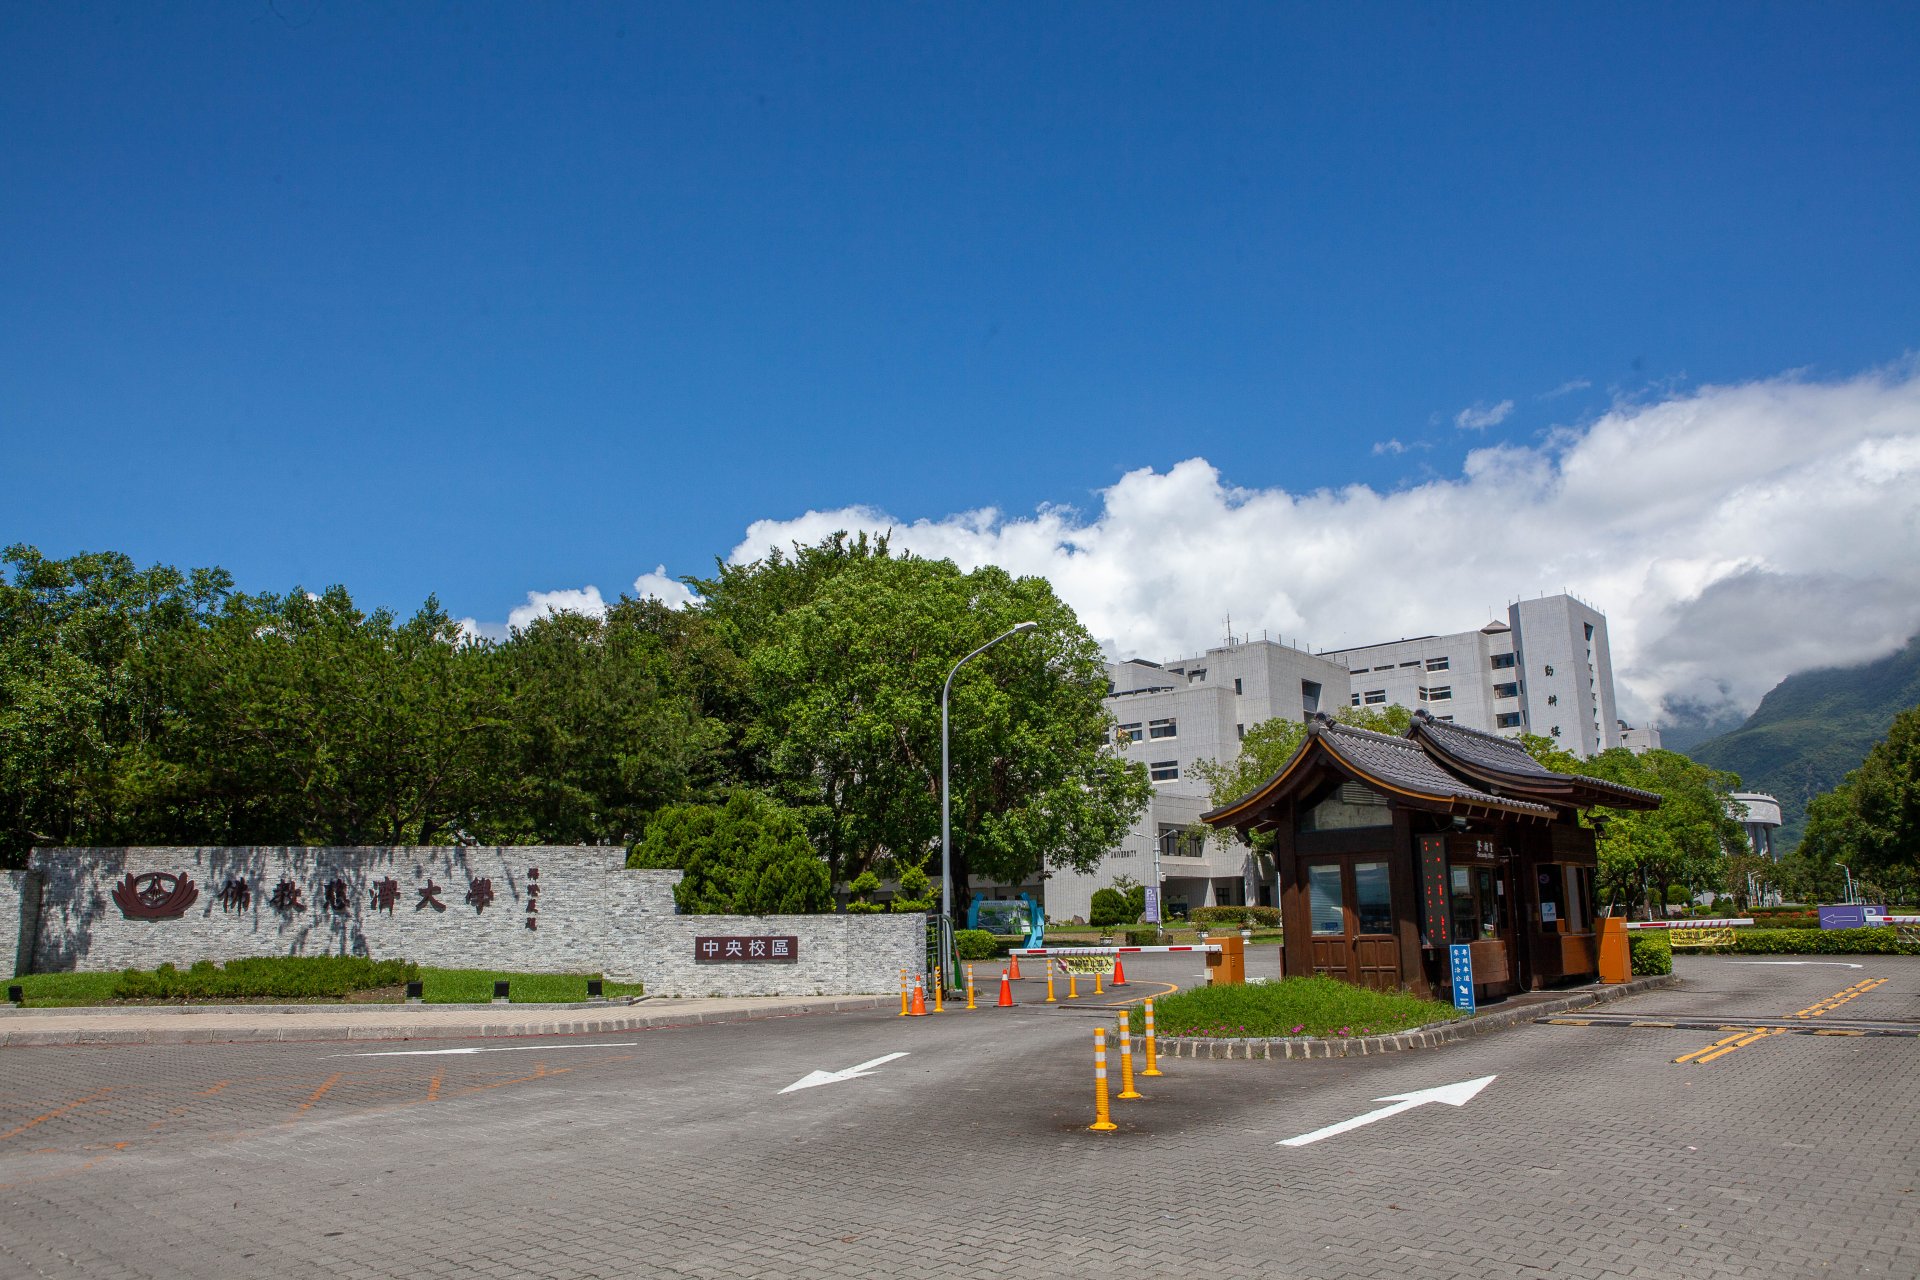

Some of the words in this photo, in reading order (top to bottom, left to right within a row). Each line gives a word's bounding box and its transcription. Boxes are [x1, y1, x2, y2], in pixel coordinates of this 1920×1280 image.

[219, 876, 494, 915] 佛教慈濟大學
[703, 939, 789, 957] 中央校區
